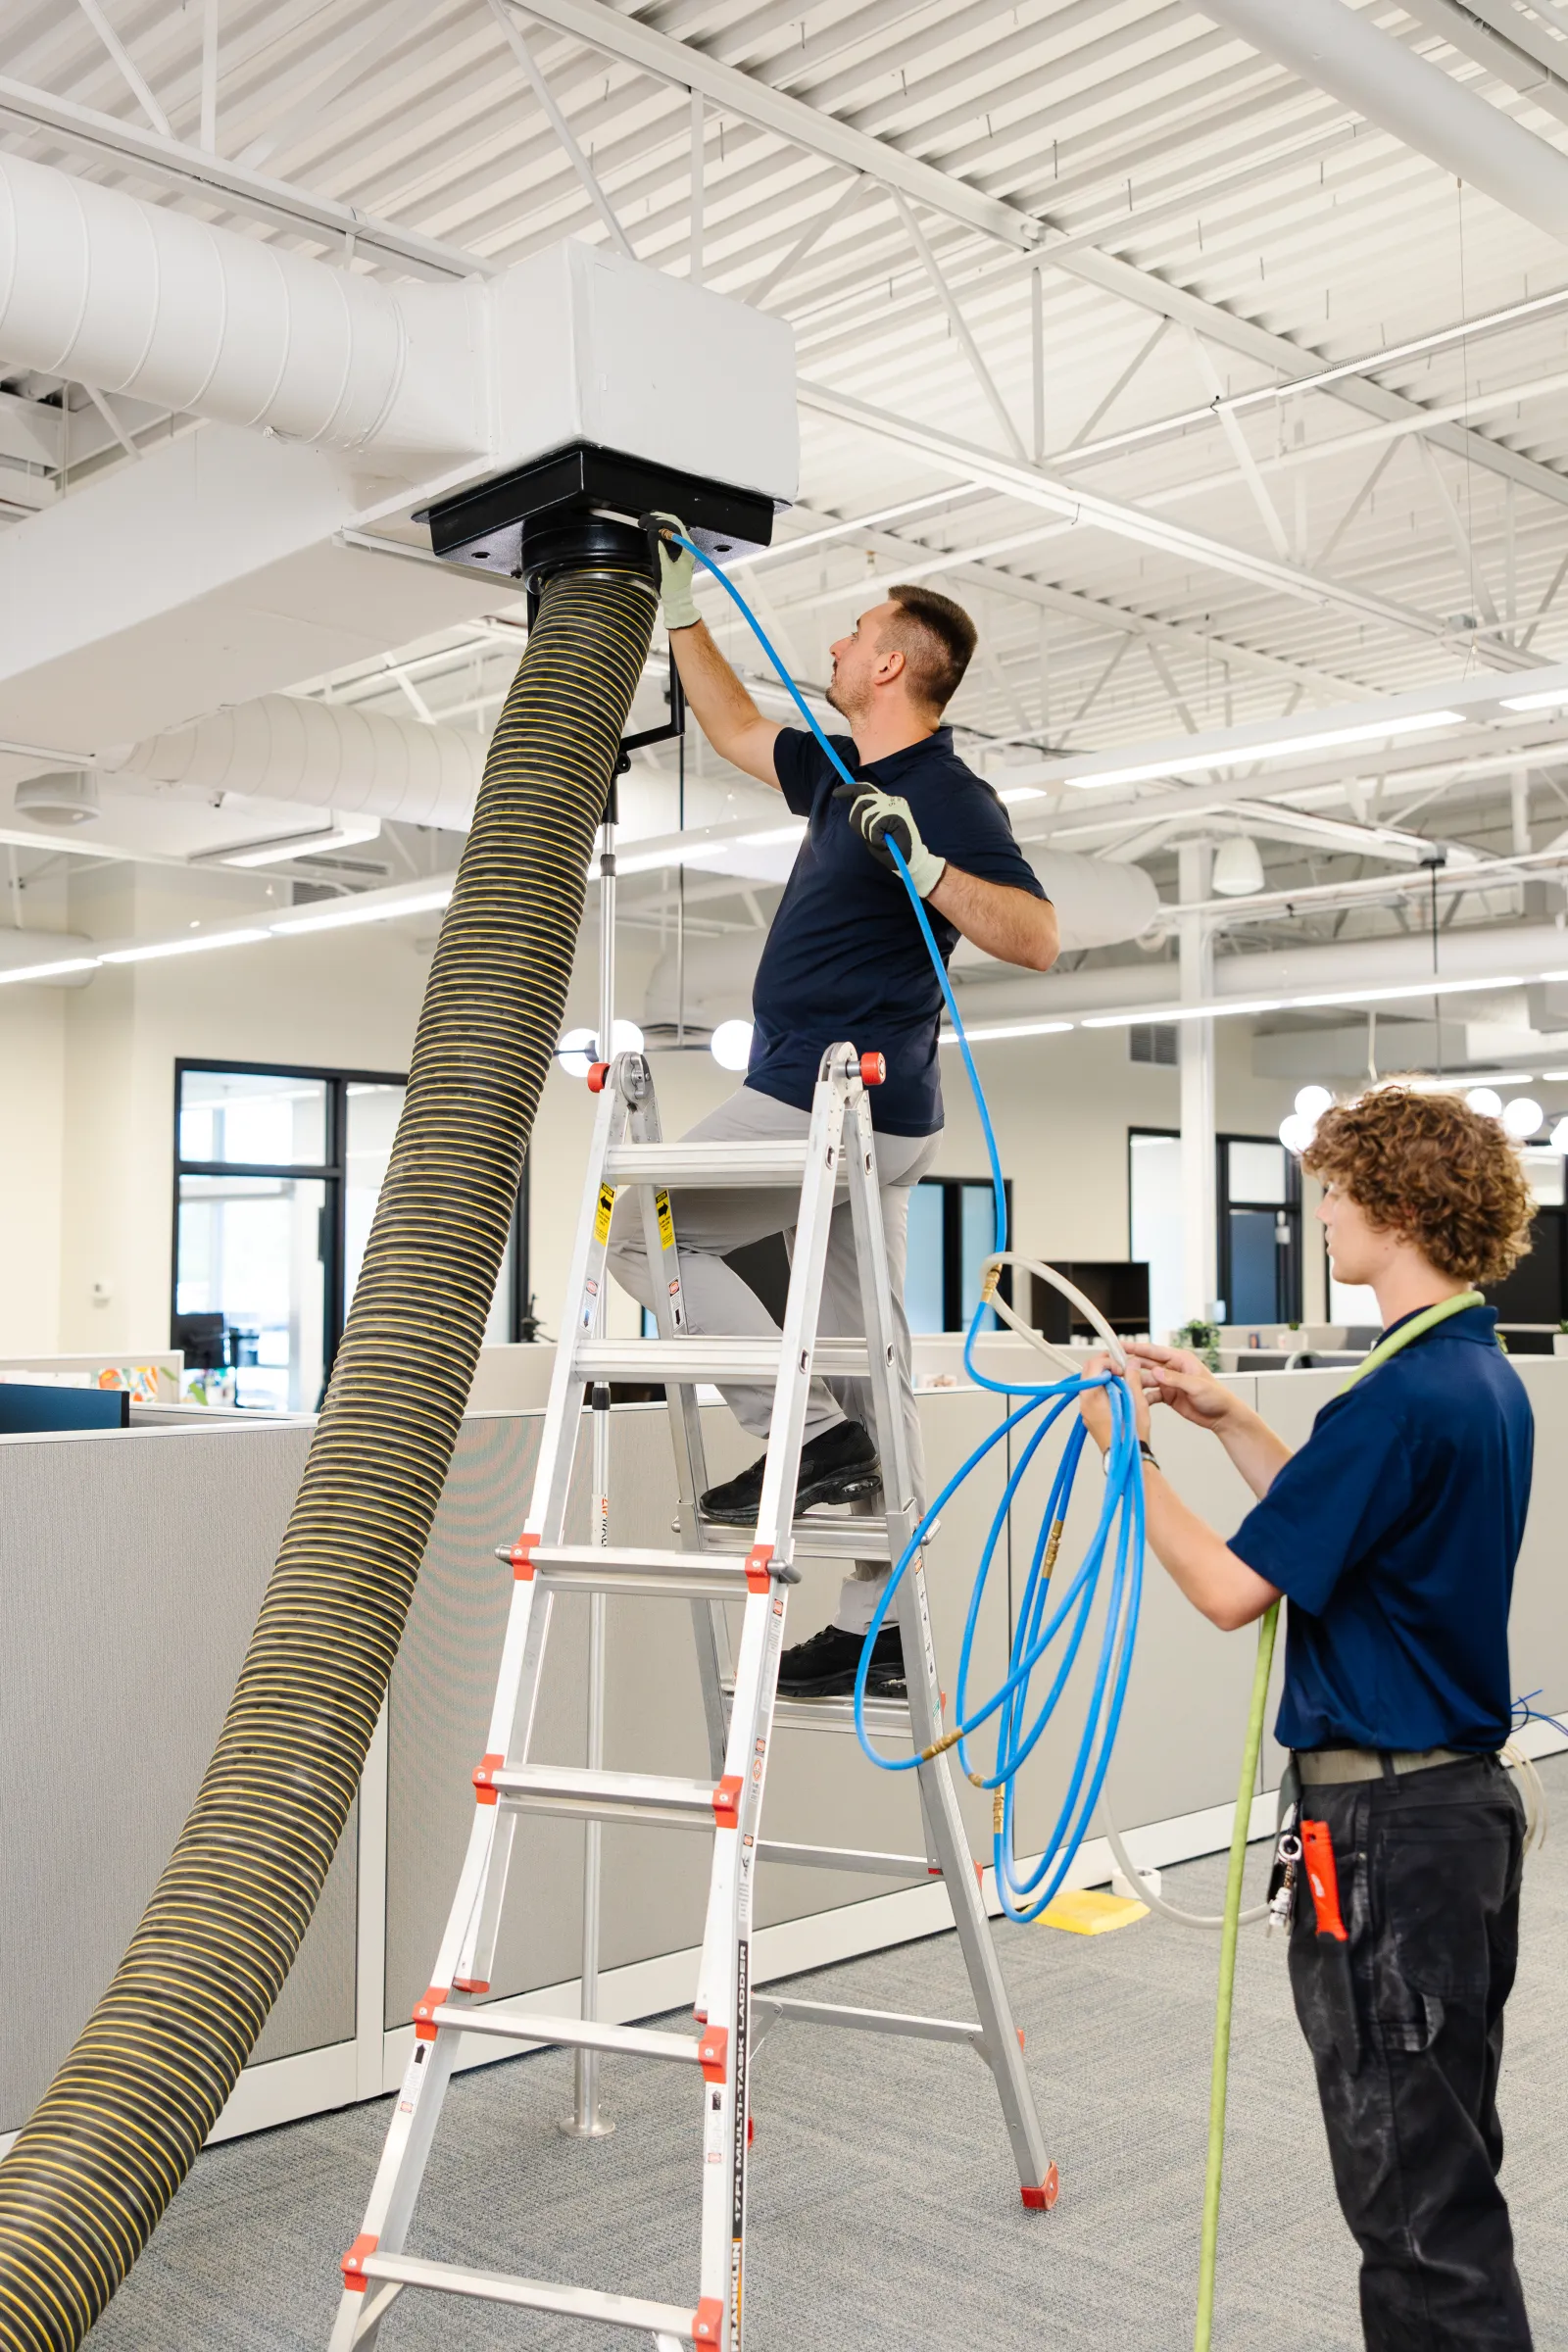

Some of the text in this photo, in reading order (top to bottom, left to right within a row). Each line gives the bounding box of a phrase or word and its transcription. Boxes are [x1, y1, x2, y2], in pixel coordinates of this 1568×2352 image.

[738, 1945, 747, 2032] LADDER
[735, 2037, 745, 2169] MULTI-TASK
[731, 2241, 741, 2352] FRANKLIN
